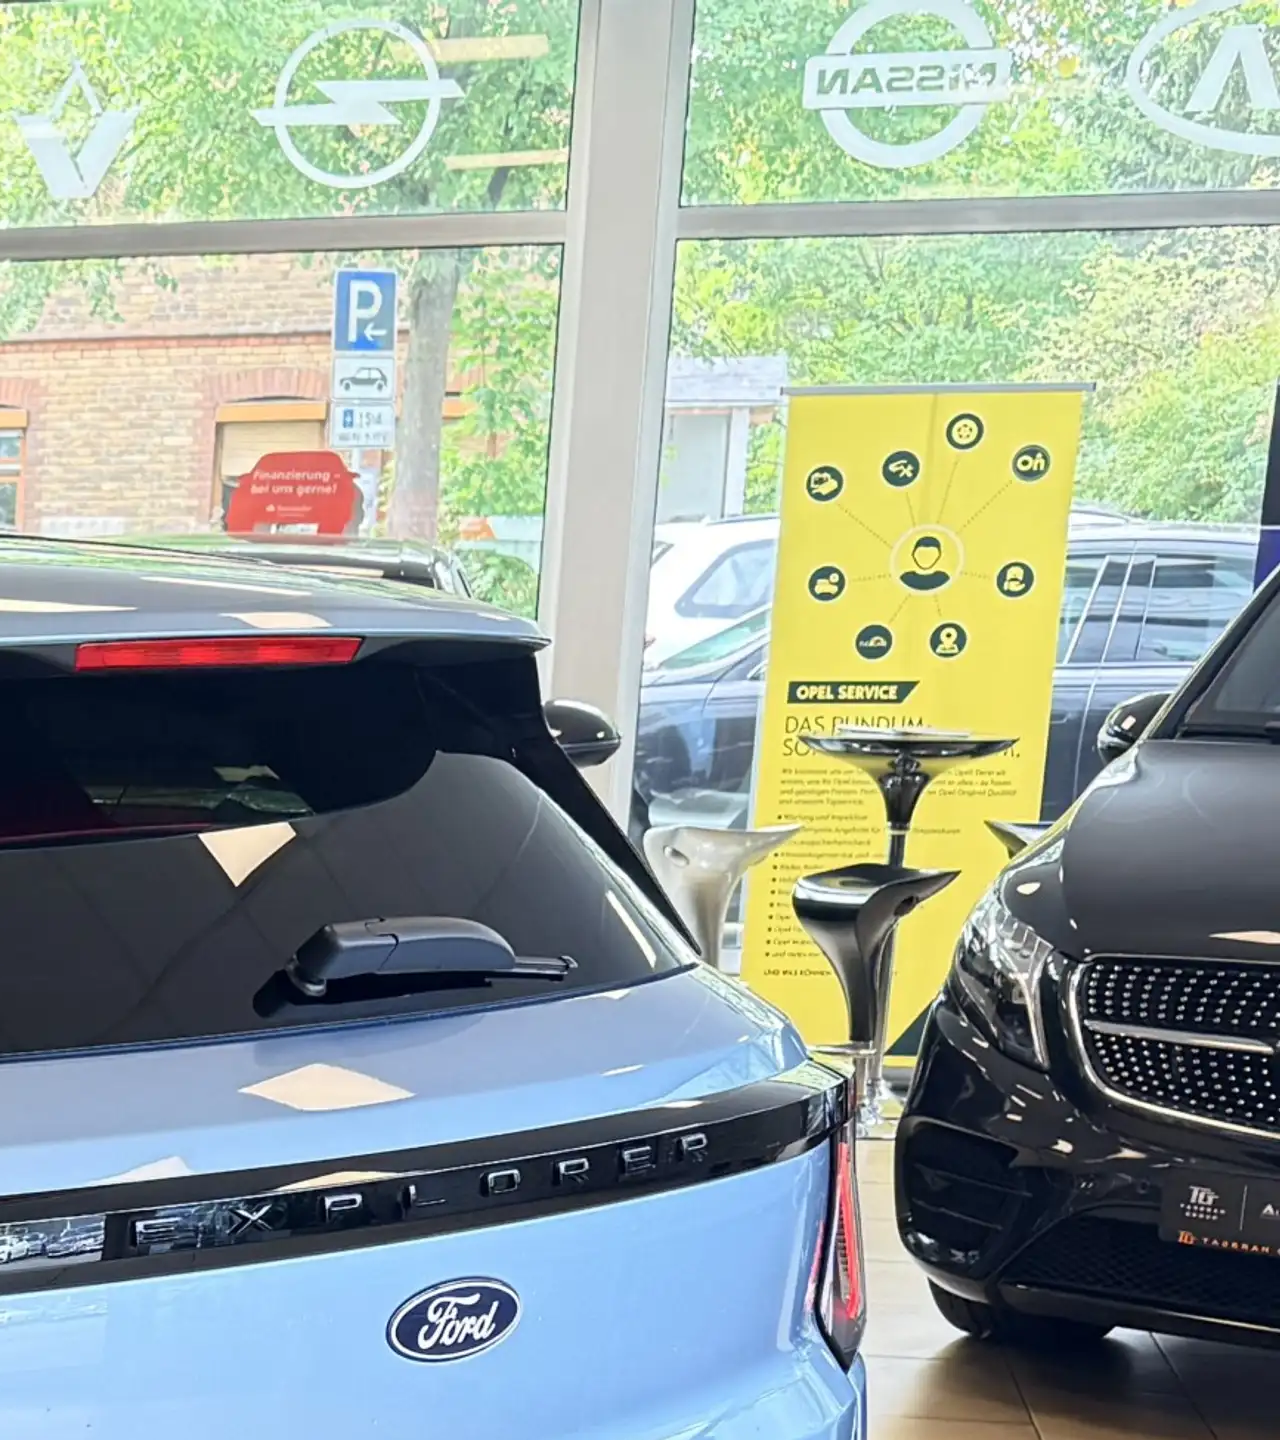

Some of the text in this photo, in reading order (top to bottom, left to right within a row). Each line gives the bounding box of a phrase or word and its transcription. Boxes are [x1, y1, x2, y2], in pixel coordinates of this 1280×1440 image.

[348, 280, 383, 343] P
[795, 684, 899, 700] OPEL SERVICE
[784, 715, 826, 735] DAS
[133, 1131, 709, 1247] EXPLORER
[417, 1292, 500, 1350] Ford
